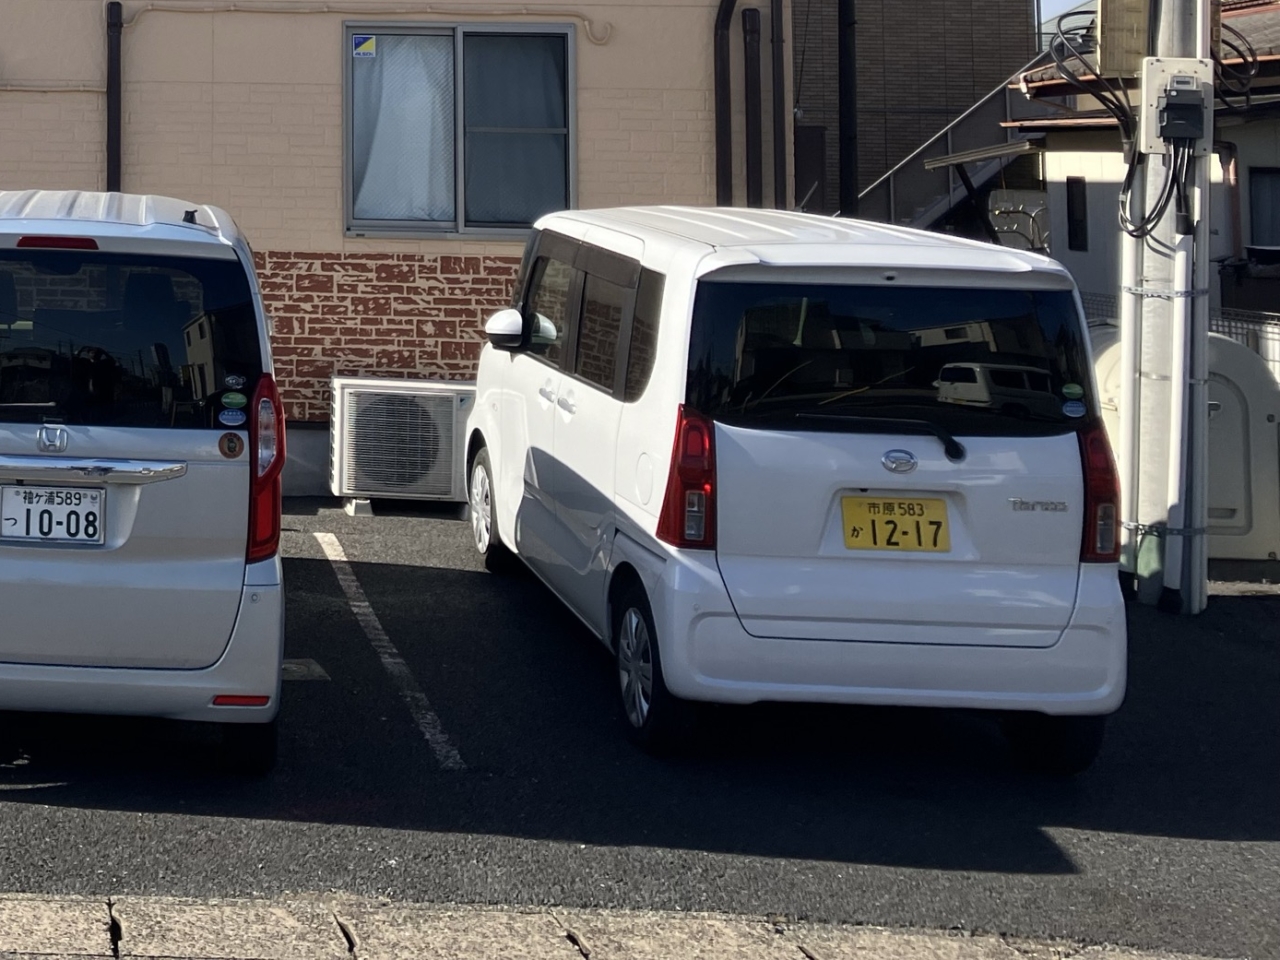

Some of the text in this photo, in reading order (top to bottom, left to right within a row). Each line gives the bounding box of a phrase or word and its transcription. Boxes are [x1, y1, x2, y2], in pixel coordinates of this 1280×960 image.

[3, 508, 98, 538] つ 10-08
[871, 519, 943, 547] 12-17
